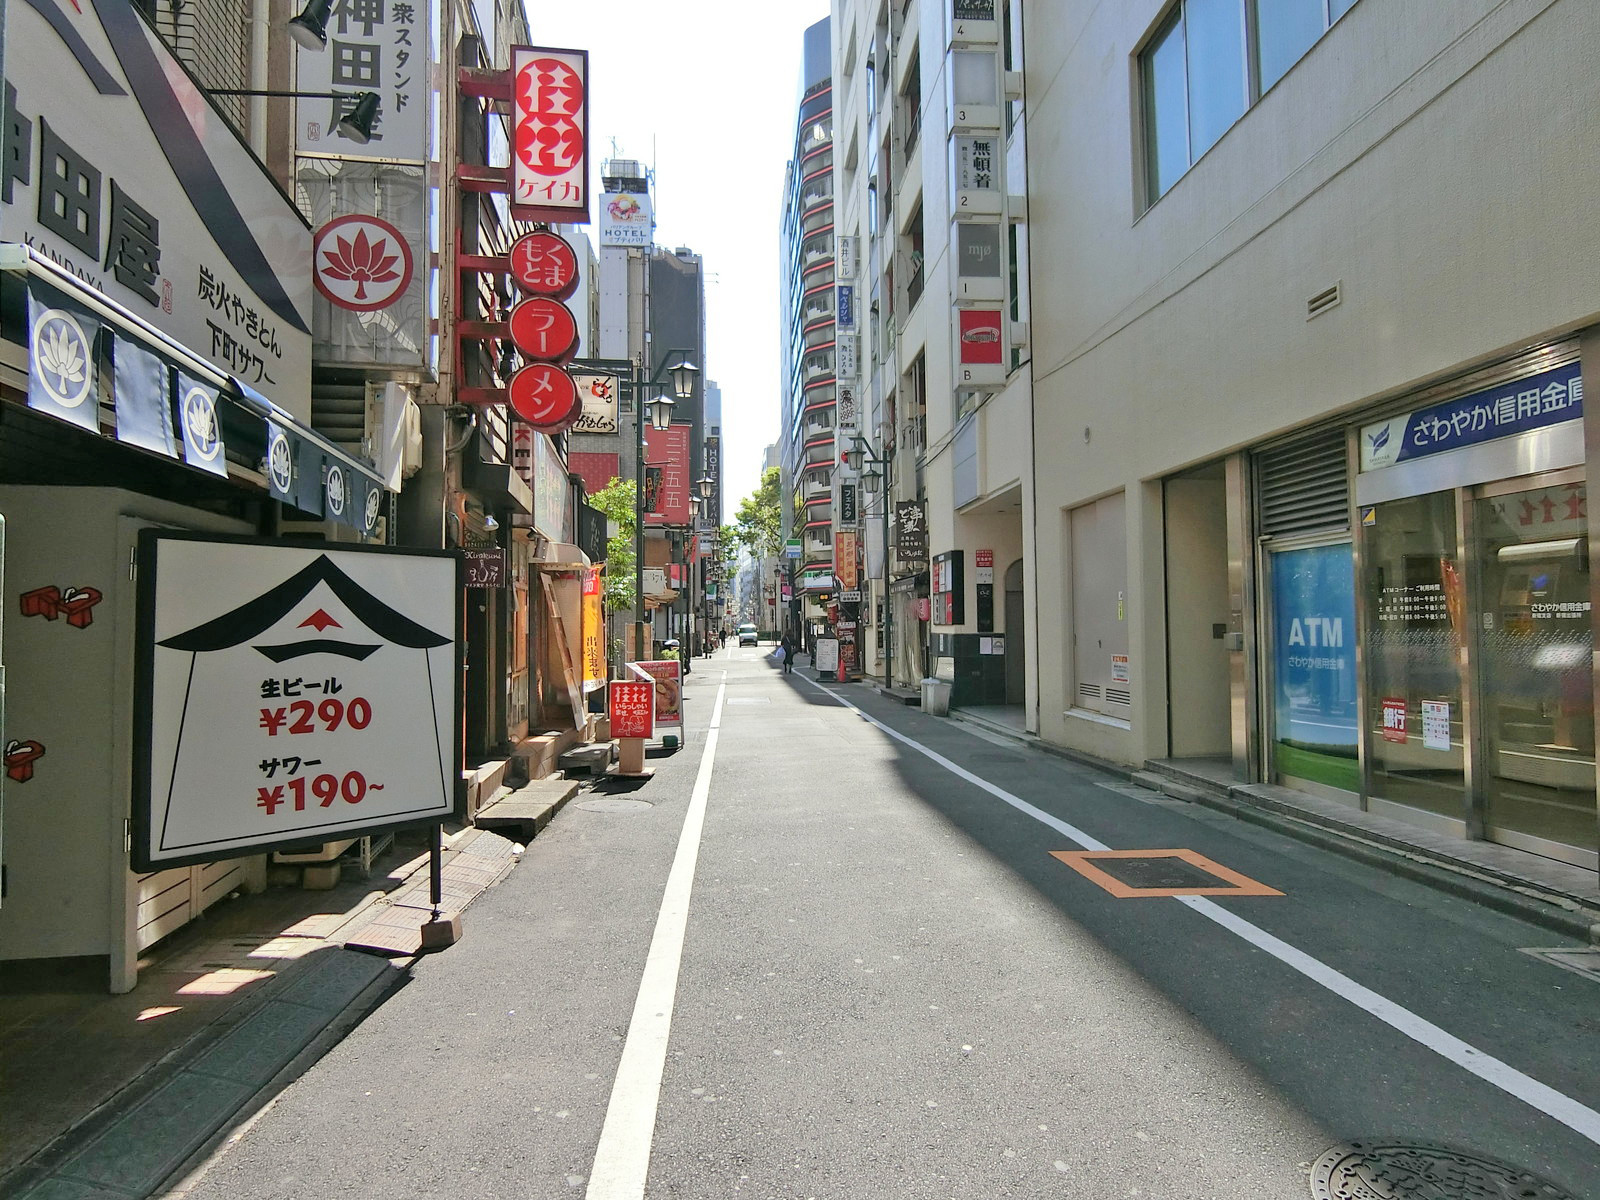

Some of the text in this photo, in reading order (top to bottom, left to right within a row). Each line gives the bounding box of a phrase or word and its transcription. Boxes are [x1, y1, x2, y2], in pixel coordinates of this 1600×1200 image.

[957, 25, 964, 35] 4
[958, 110, 965, 121] 3
[972, 140, 991, 188] 無頓着
[518, 178, 580, 202] ケイカ
[961, 196, 968, 206] 2
[841, 239, 850, 276] 酒井ビル
[198, 264, 282, 359] 炭火やきとん
[206, 318, 276, 384] 下町サワー
[964, 370, 971, 380] B
[843, 489, 852, 517] フェスタ
[1531, 602, 1591, 612] さわやか信用金庫
[1288, 618, 1343, 647] ATM
[1288, 656, 1344, 670] さわやか信用金庫
[261, 676, 343, 698] 生ビール
[259, 696, 372, 736] ¥290
[258, 756, 322, 778] サワー
